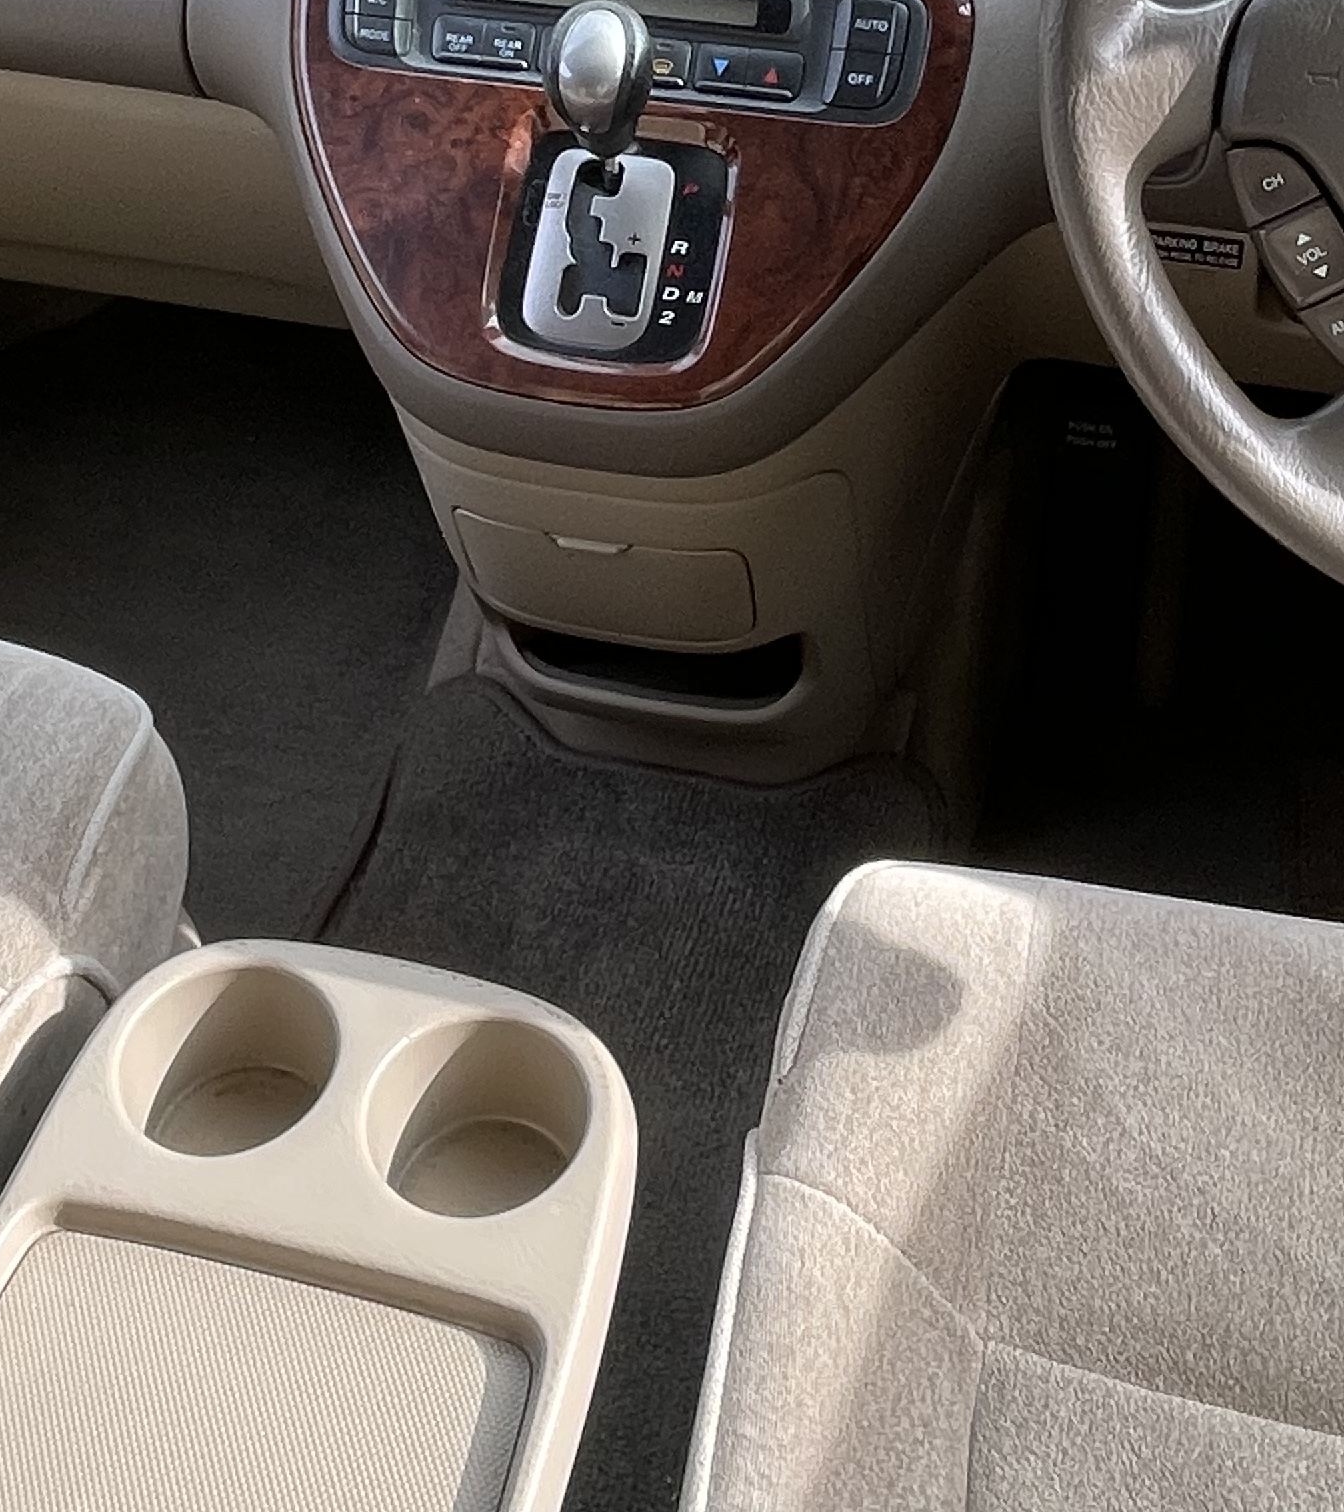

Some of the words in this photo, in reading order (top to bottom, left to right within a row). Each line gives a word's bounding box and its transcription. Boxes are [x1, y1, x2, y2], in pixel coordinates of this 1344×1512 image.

[855, 18, 889, 32] AUTO
[446, 32, 474, 45] REAR
[494, 38, 522, 50] REAR
[847, 72, 874, 86] OFF
[1262, 172, 1286, 192] CH
[670, 240, 689, 255] R
[1296, 245, 1328, 266] VOL
[666, 264, 684, 278] N
[662, 286, 680, 301] D
[685, 290, 704, 304] M
[658, 310, 676, 326] 2
